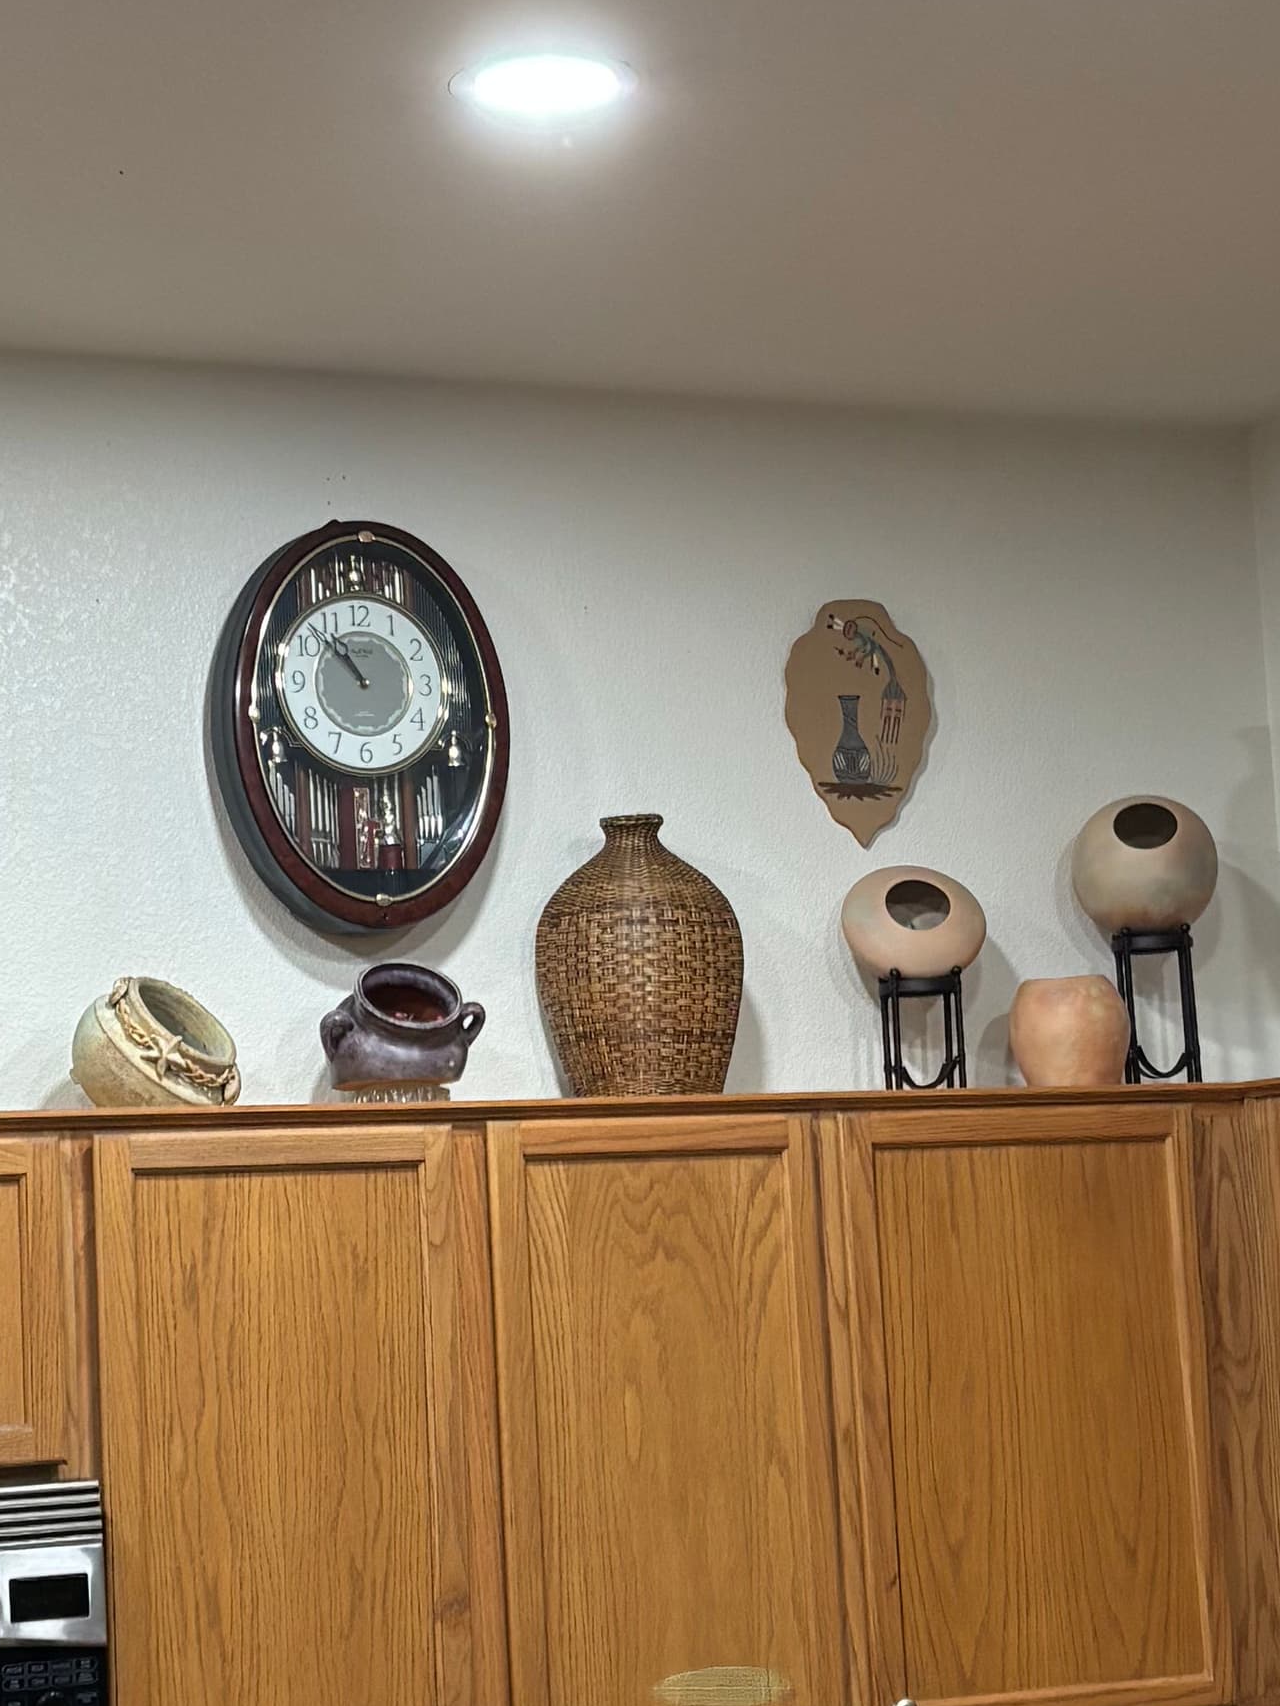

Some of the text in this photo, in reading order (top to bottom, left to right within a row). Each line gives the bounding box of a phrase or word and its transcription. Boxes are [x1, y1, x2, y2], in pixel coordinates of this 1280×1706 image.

[321, 612, 338, 633] 11
[349, 605, 370, 627] 12
[387, 614, 394, 636] 1
[297, 634, 320, 657] 10
[409, 638, 423, 661] 2
[292, 670, 306, 693] 9
[420, 674, 432, 696] 3
[303, 706, 318, 729] 8
[409, 708, 426, 731] 4
[328, 732, 342, 754] 7
[360, 742, 373, 763] 6
[392, 734, 403, 755] 5
